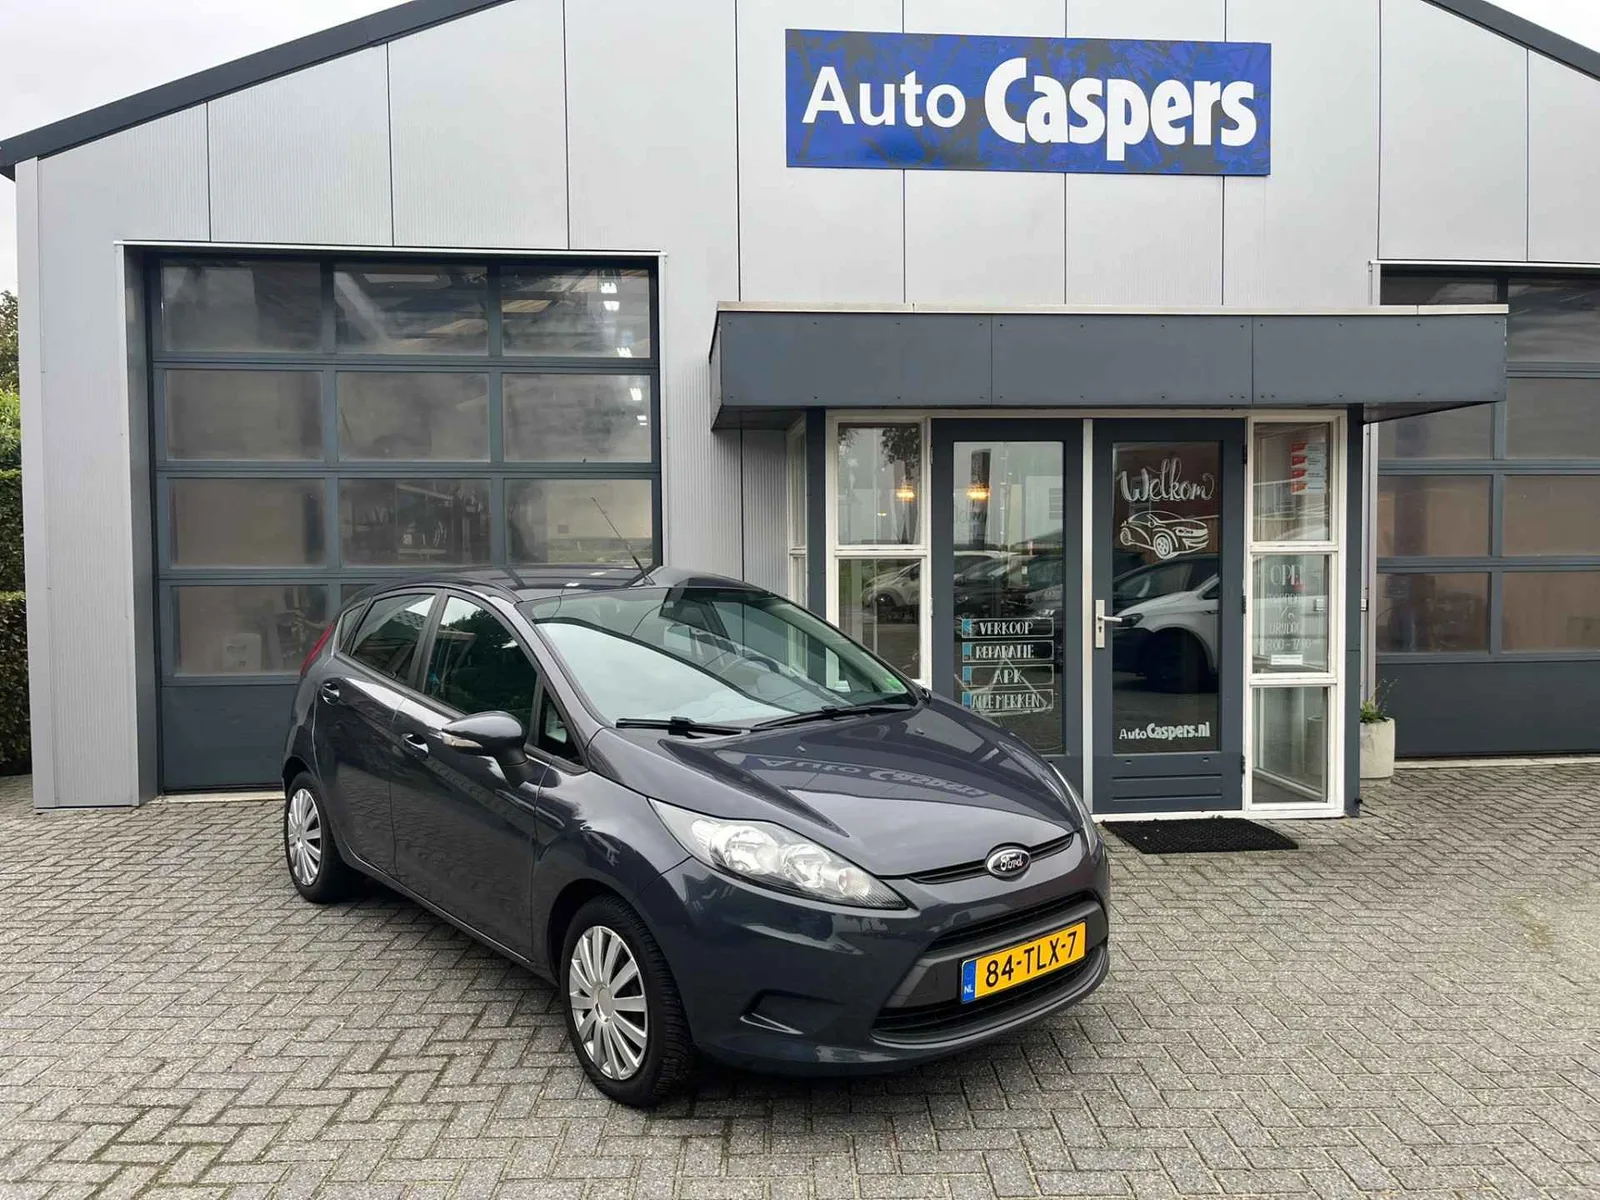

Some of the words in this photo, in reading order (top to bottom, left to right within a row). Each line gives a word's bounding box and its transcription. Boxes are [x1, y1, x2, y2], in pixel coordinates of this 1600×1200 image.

[802, 66, 966, 128] Auto
[984, 57, 1257, 162] Caspers
[1116, 458, 1215, 502] Welkom
[979, 621, 1034, 635] VERKOOP
[975, 644, 1034, 659] REPARATIE
[993, 669, 1022, 684] APK
[995, 693, 1040, 709] MERKEN
[1000, 853, 1023, 871] Ford
[985, 931, 1077, 987] 84-TLX-7
[963, 986, 973, 994] NL
